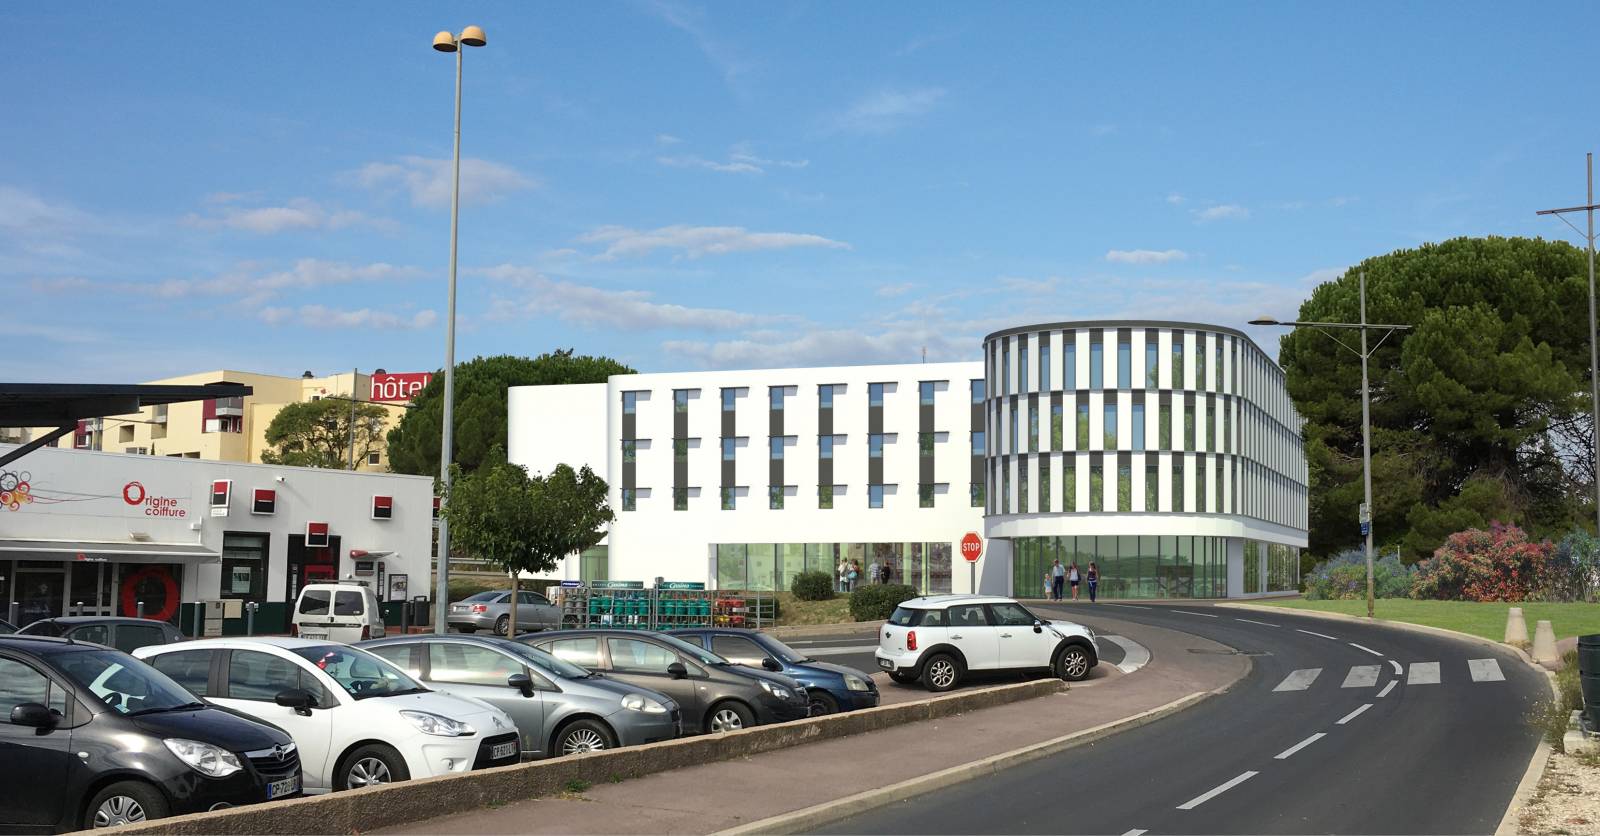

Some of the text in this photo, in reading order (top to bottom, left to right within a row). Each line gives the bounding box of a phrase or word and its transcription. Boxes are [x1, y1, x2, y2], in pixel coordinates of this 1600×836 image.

[371, 375, 427, 399] hôtel
[123, 481, 177, 508] Origine
[145, 507, 186, 517] coiffure
[962, 542, 979, 552] STOP
